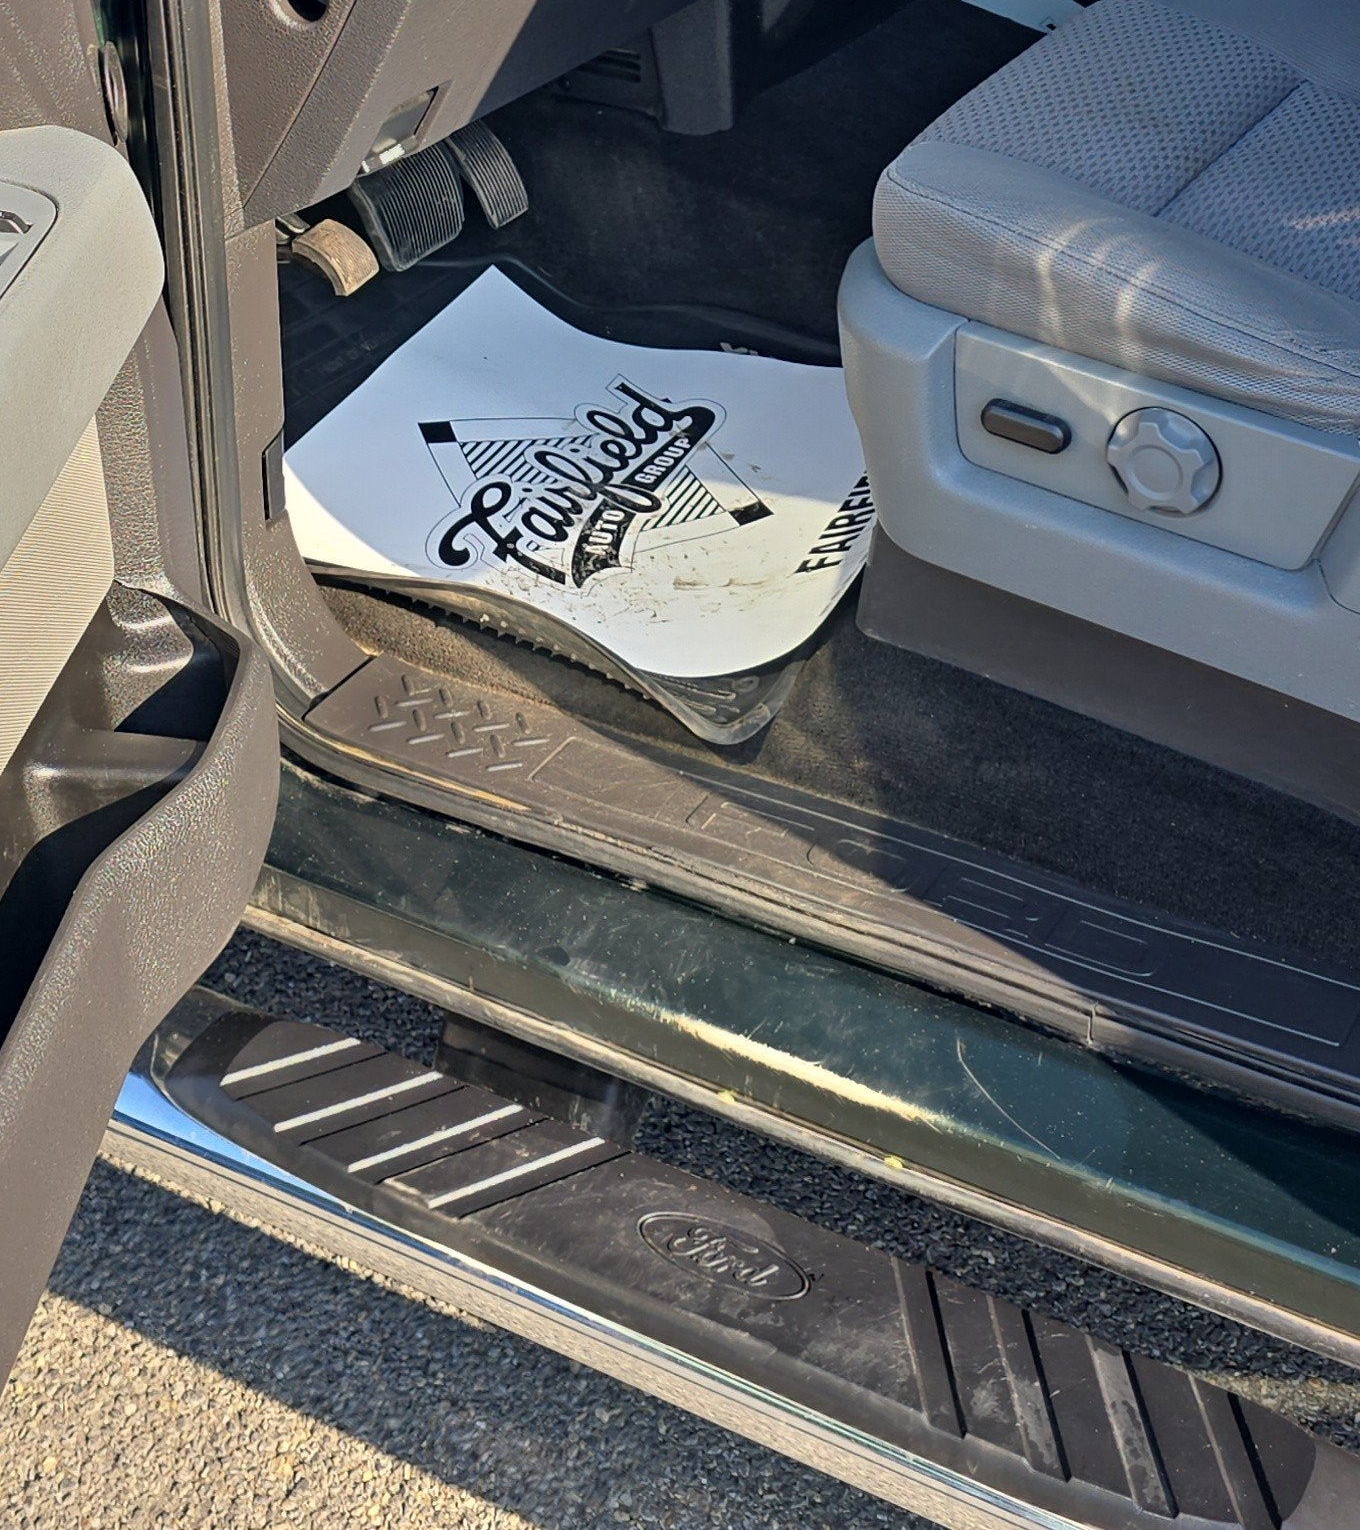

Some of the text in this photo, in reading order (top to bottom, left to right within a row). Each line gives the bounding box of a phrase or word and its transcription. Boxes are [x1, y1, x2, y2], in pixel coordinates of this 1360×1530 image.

[438, 381, 716, 586] Fairfield
[584, 436, 692, 557] AUTO GROUP
[794, 469, 876, 575] FAIRFI
[666, 1226, 780, 1287] Ford
